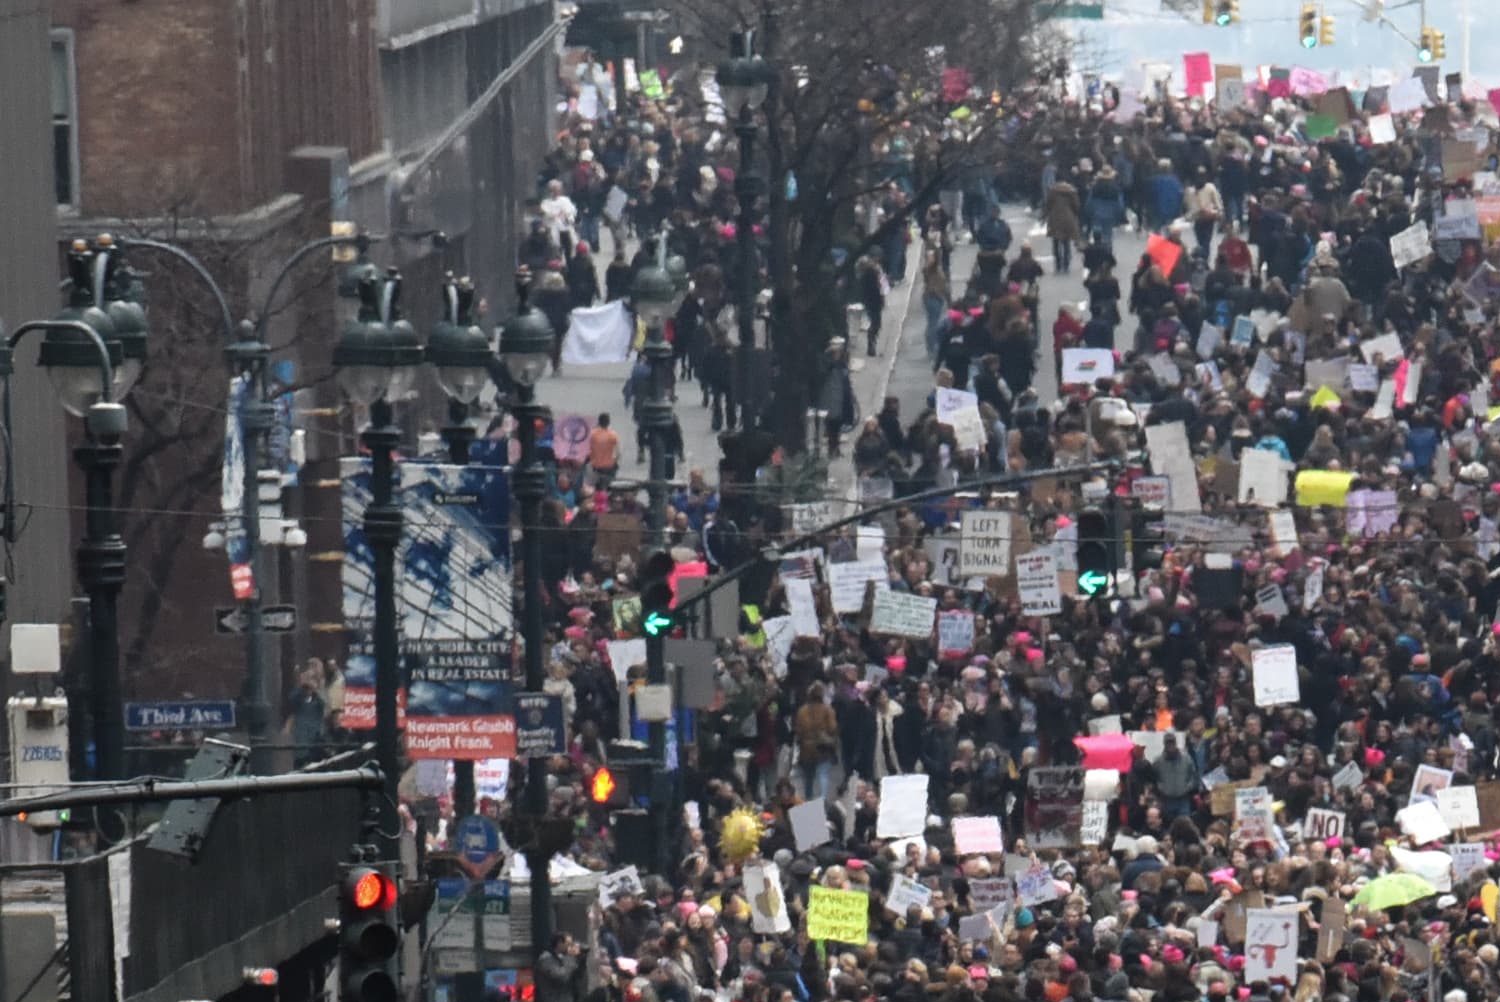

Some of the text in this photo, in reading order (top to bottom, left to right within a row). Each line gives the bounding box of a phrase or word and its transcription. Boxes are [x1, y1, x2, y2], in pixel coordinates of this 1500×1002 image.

[972, 519, 1000, 533] LEFT
[972, 539, 1000, 549] TURN
[963, 551, 1006, 567] SIGNAL
[140, 707, 186, 725] Third
[407, 720, 514, 734] Newmark Grubb
[407, 736, 451, 752] Knight
[1313, 813, 1340, 839] NO
